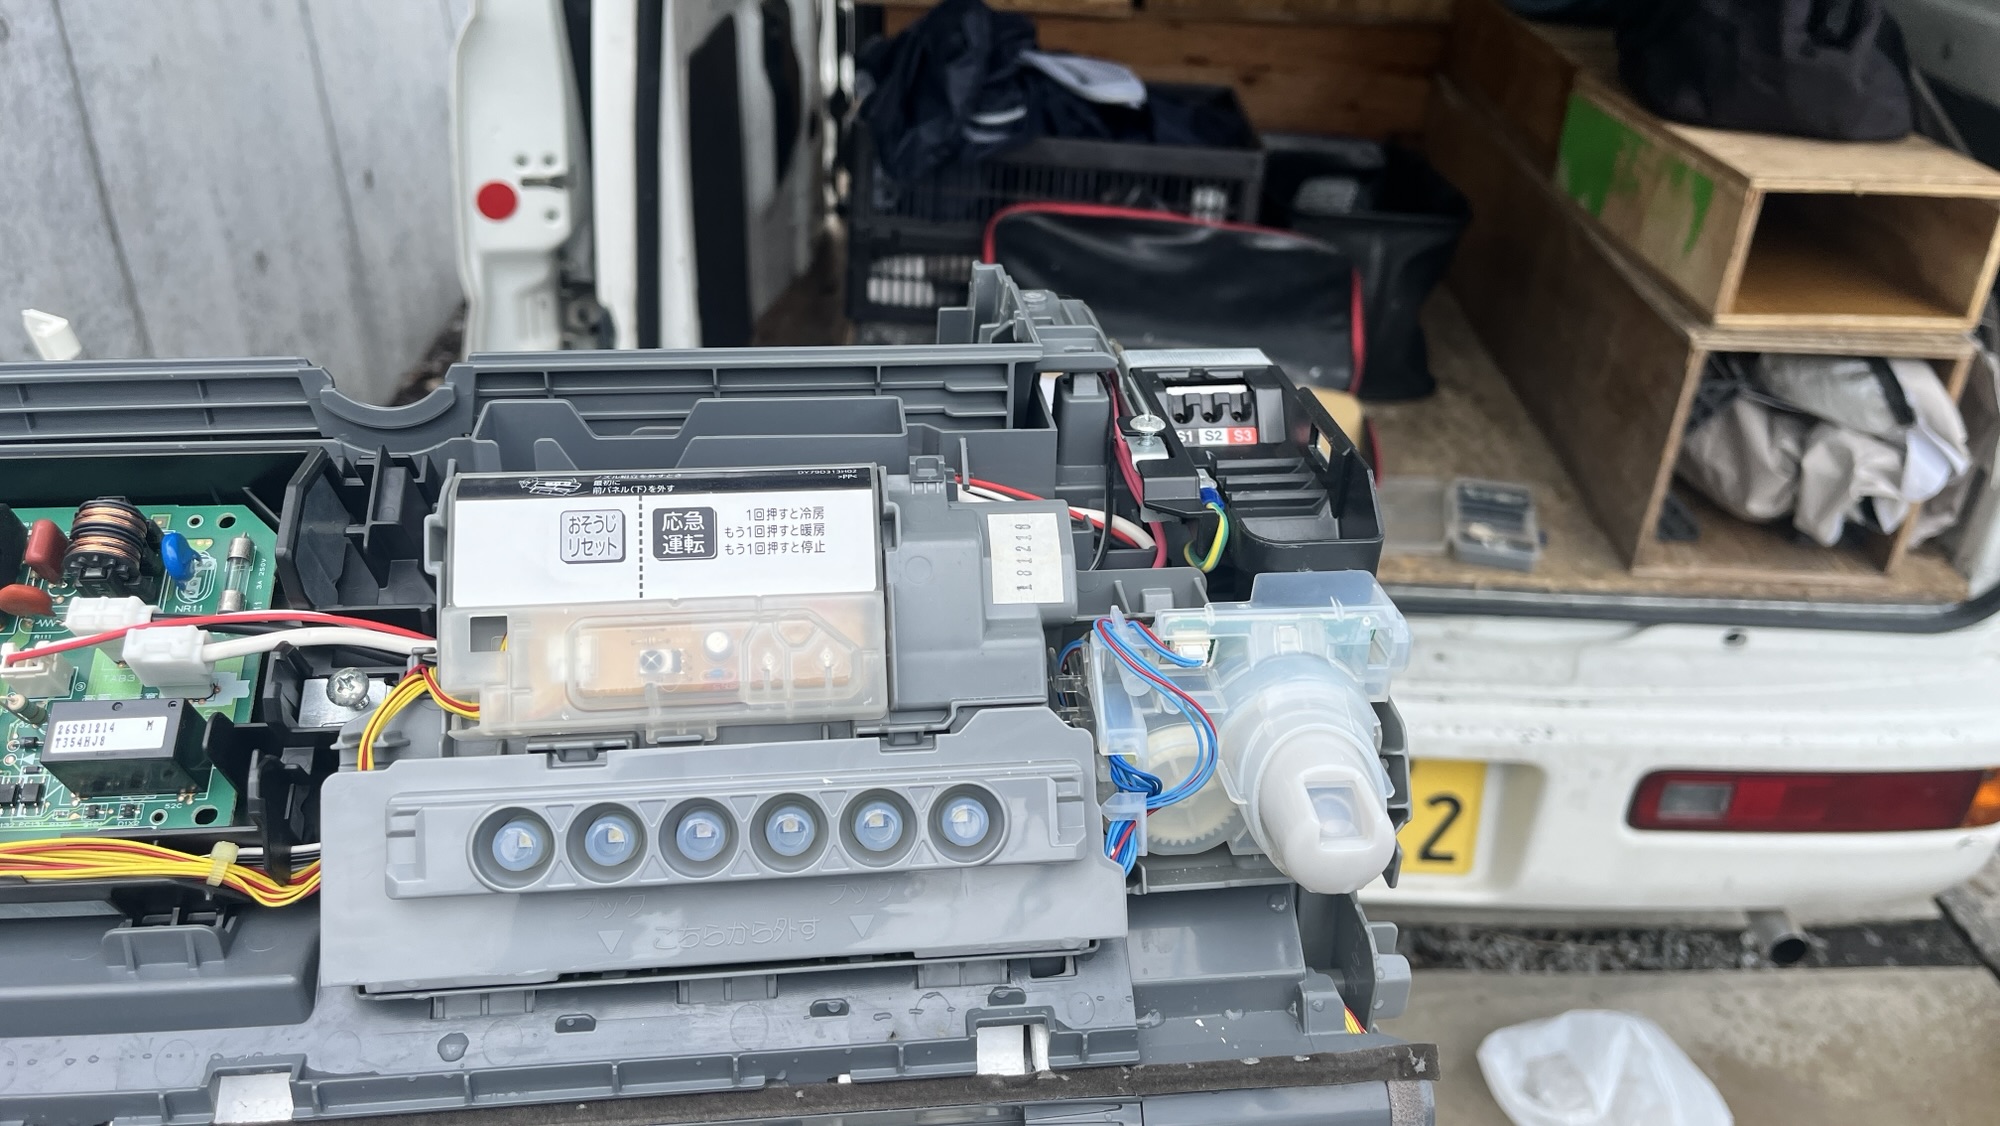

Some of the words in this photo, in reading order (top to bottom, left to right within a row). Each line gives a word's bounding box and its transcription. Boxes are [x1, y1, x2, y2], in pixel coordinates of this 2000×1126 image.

[1205, 430, 1222, 442] S2
[1234, 429, 1252, 442] S3
[592, 485, 675, 495] 前パネル(下)を外す
[661, 511, 705, 532] 応急
[746, 506, 825, 521] 1回押すと冷房
[568, 514, 617, 535] おそうじ
[724, 523, 826, 539] もう1回押すと暖房
[568, 537, 617, 557] リセット
[662, 534, 705, 555] 運転
[724, 541, 826, 556] もう1回押すと停止
[1014, 523, 1033, 591] 181218
[175, 605, 203, 613] NR11
[57, 722, 115, 735] 26S81214
[146, 720, 154, 731] M
[55, 736, 106, 749] T354HJ8
[1417, 791, 1461, 862] 2
[826, 880, 895, 905] フック
[575, 894, 646, 920] フック
[653, 916, 821, 950] こちらから外す
